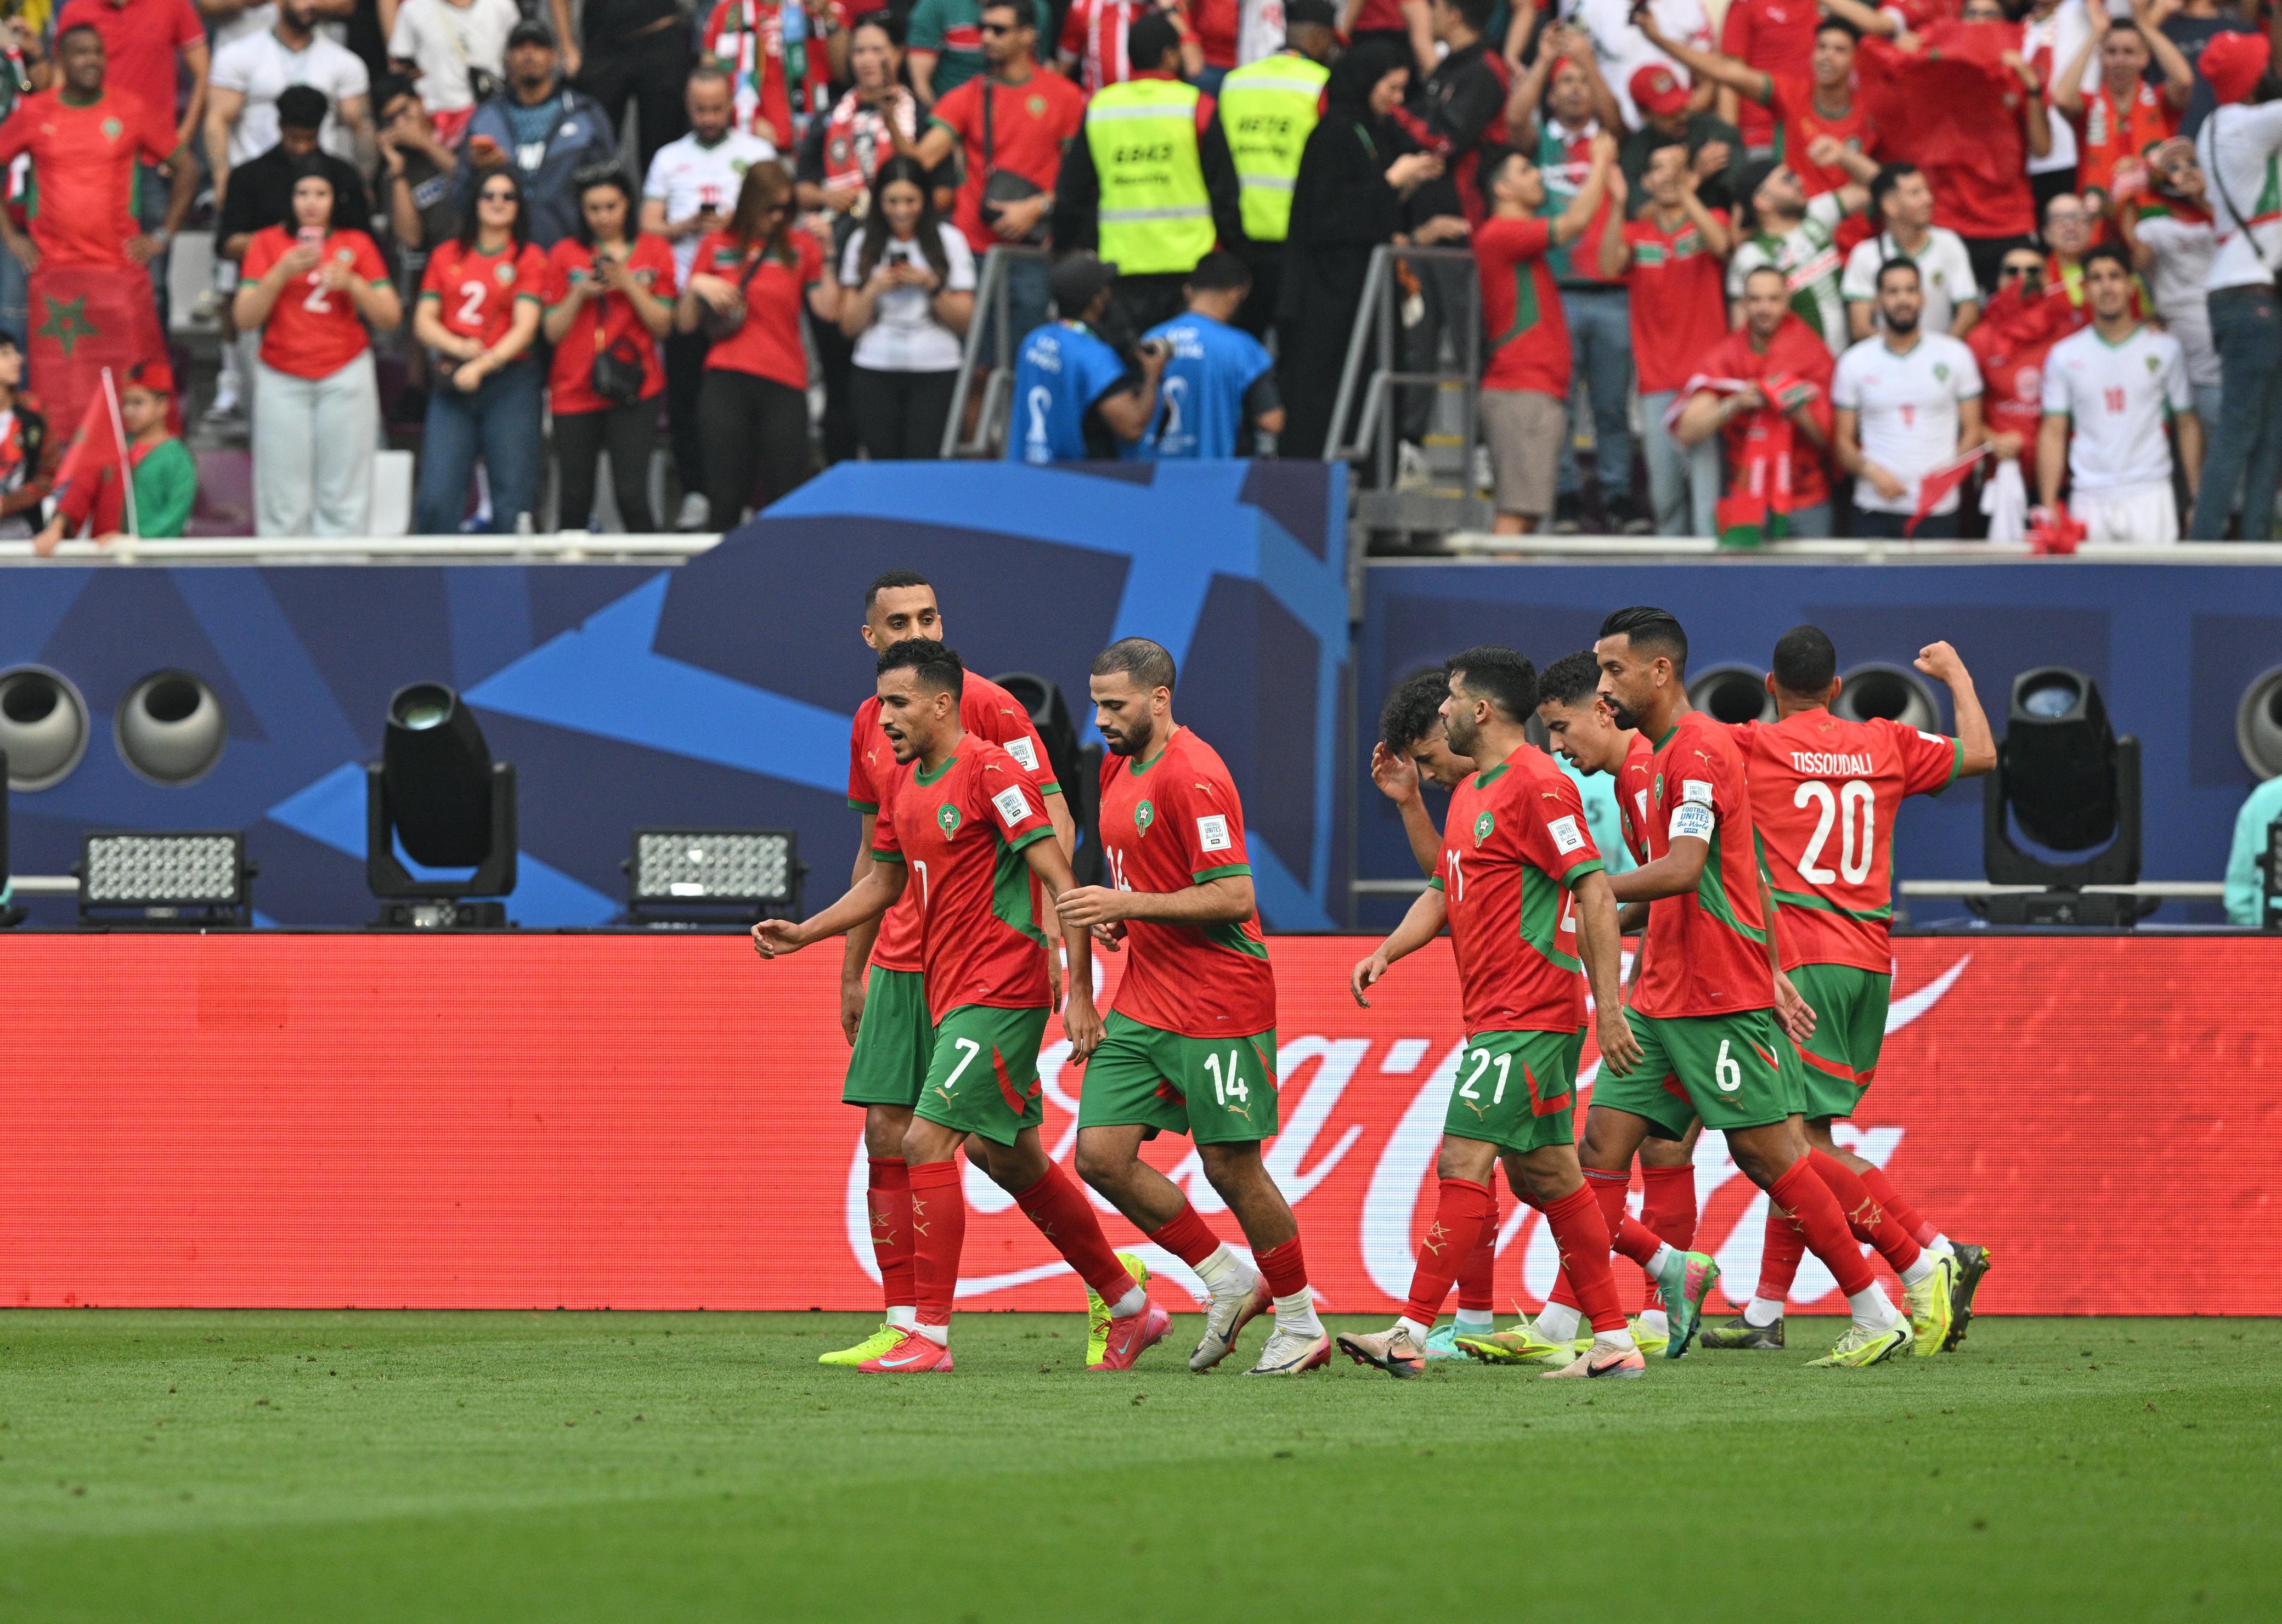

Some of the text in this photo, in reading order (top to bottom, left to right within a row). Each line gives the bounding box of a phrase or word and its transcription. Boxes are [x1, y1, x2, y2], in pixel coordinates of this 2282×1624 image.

[302, 271, 331, 314] 2
[456, 280, 487, 325] 2
[1011, 743, 1026, 751] FOOTBALL
[1012, 748, 1028, 757] UNITES
[1790, 752, 1873, 775] TISSOUDALI
[1001, 793, 1016, 803] FOOTBALL
[1003, 797, 1019, 809] UNITES
[1011, 802, 1021, 811] World
[1682, 807, 1710, 816] FOOTBALL
[1558, 826, 1574, 836] UNITES
[1681, 813, 1709, 823] UNITES
[1688, 821, 1709, 830] World
[1794, 780, 1874, 885] 20
[1107, 845, 1132, 892] 14
[913, 860, 927, 911] 7
[945, 1038, 980, 1088] 7
[1204, 1050, 1249, 1105] 14
[1459, 1048, 1512, 1104] 21
[1716, 1039, 1741, 1091] 6
[1684, 1258, 1708, 1303] NIKE
